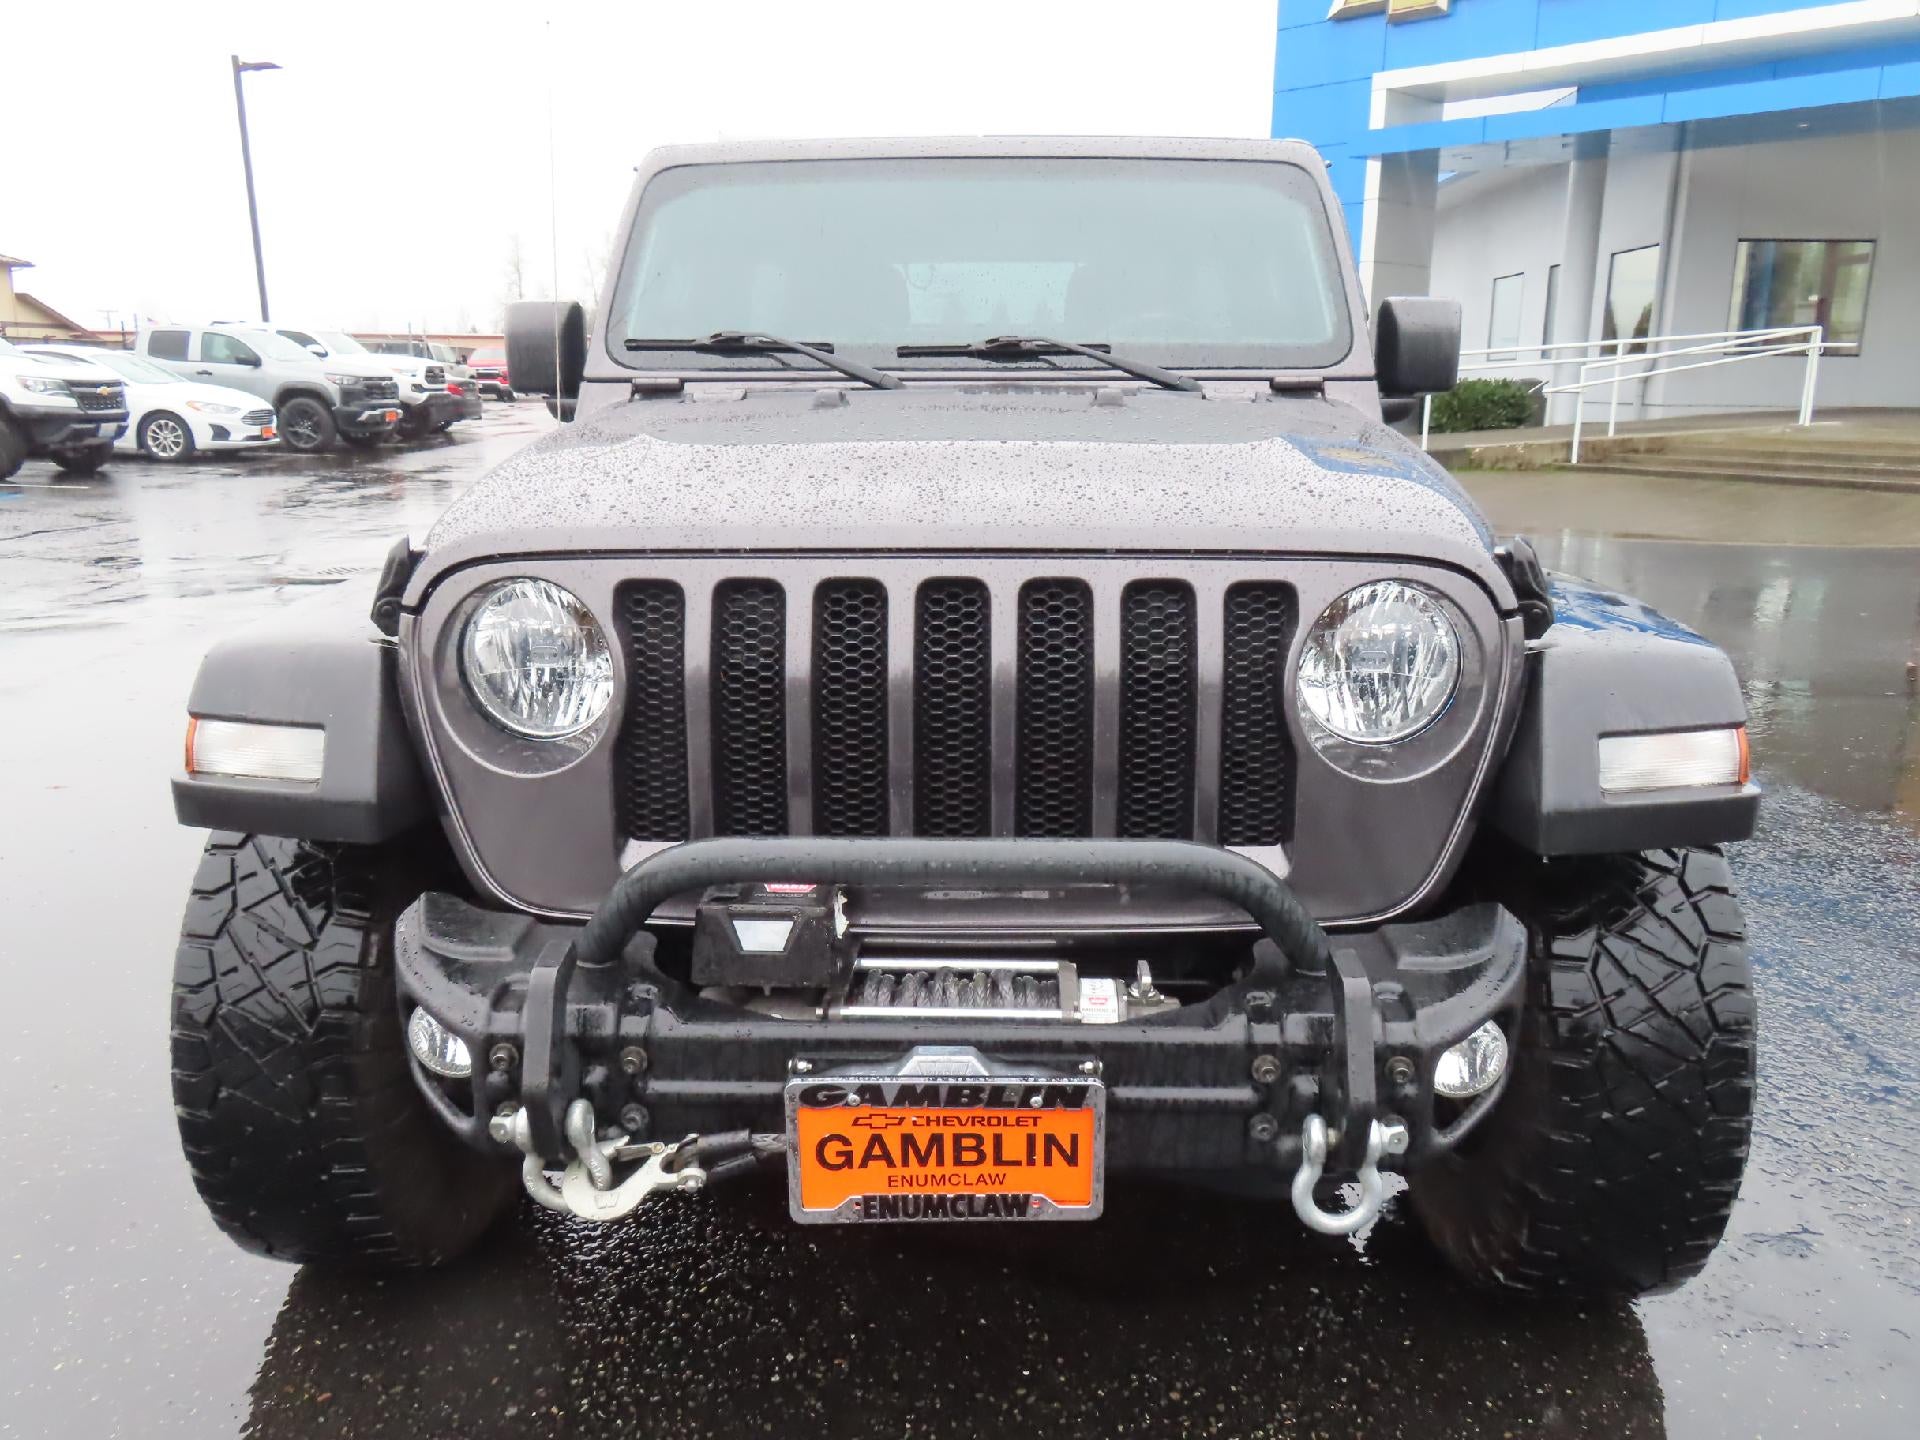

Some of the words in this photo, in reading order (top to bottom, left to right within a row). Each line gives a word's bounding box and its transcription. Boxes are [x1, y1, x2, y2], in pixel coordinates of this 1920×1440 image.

[799, 1083, 1090, 1108] GAMBLIN
[912, 1115, 1042, 1127] CHEVROLET
[815, 1133, 1079, 1171] GAMBLIN
[887, 1173, 1007, 1188] ENUMCLAW
[863, 1193, 1033, 1219] ENUMCLAW
